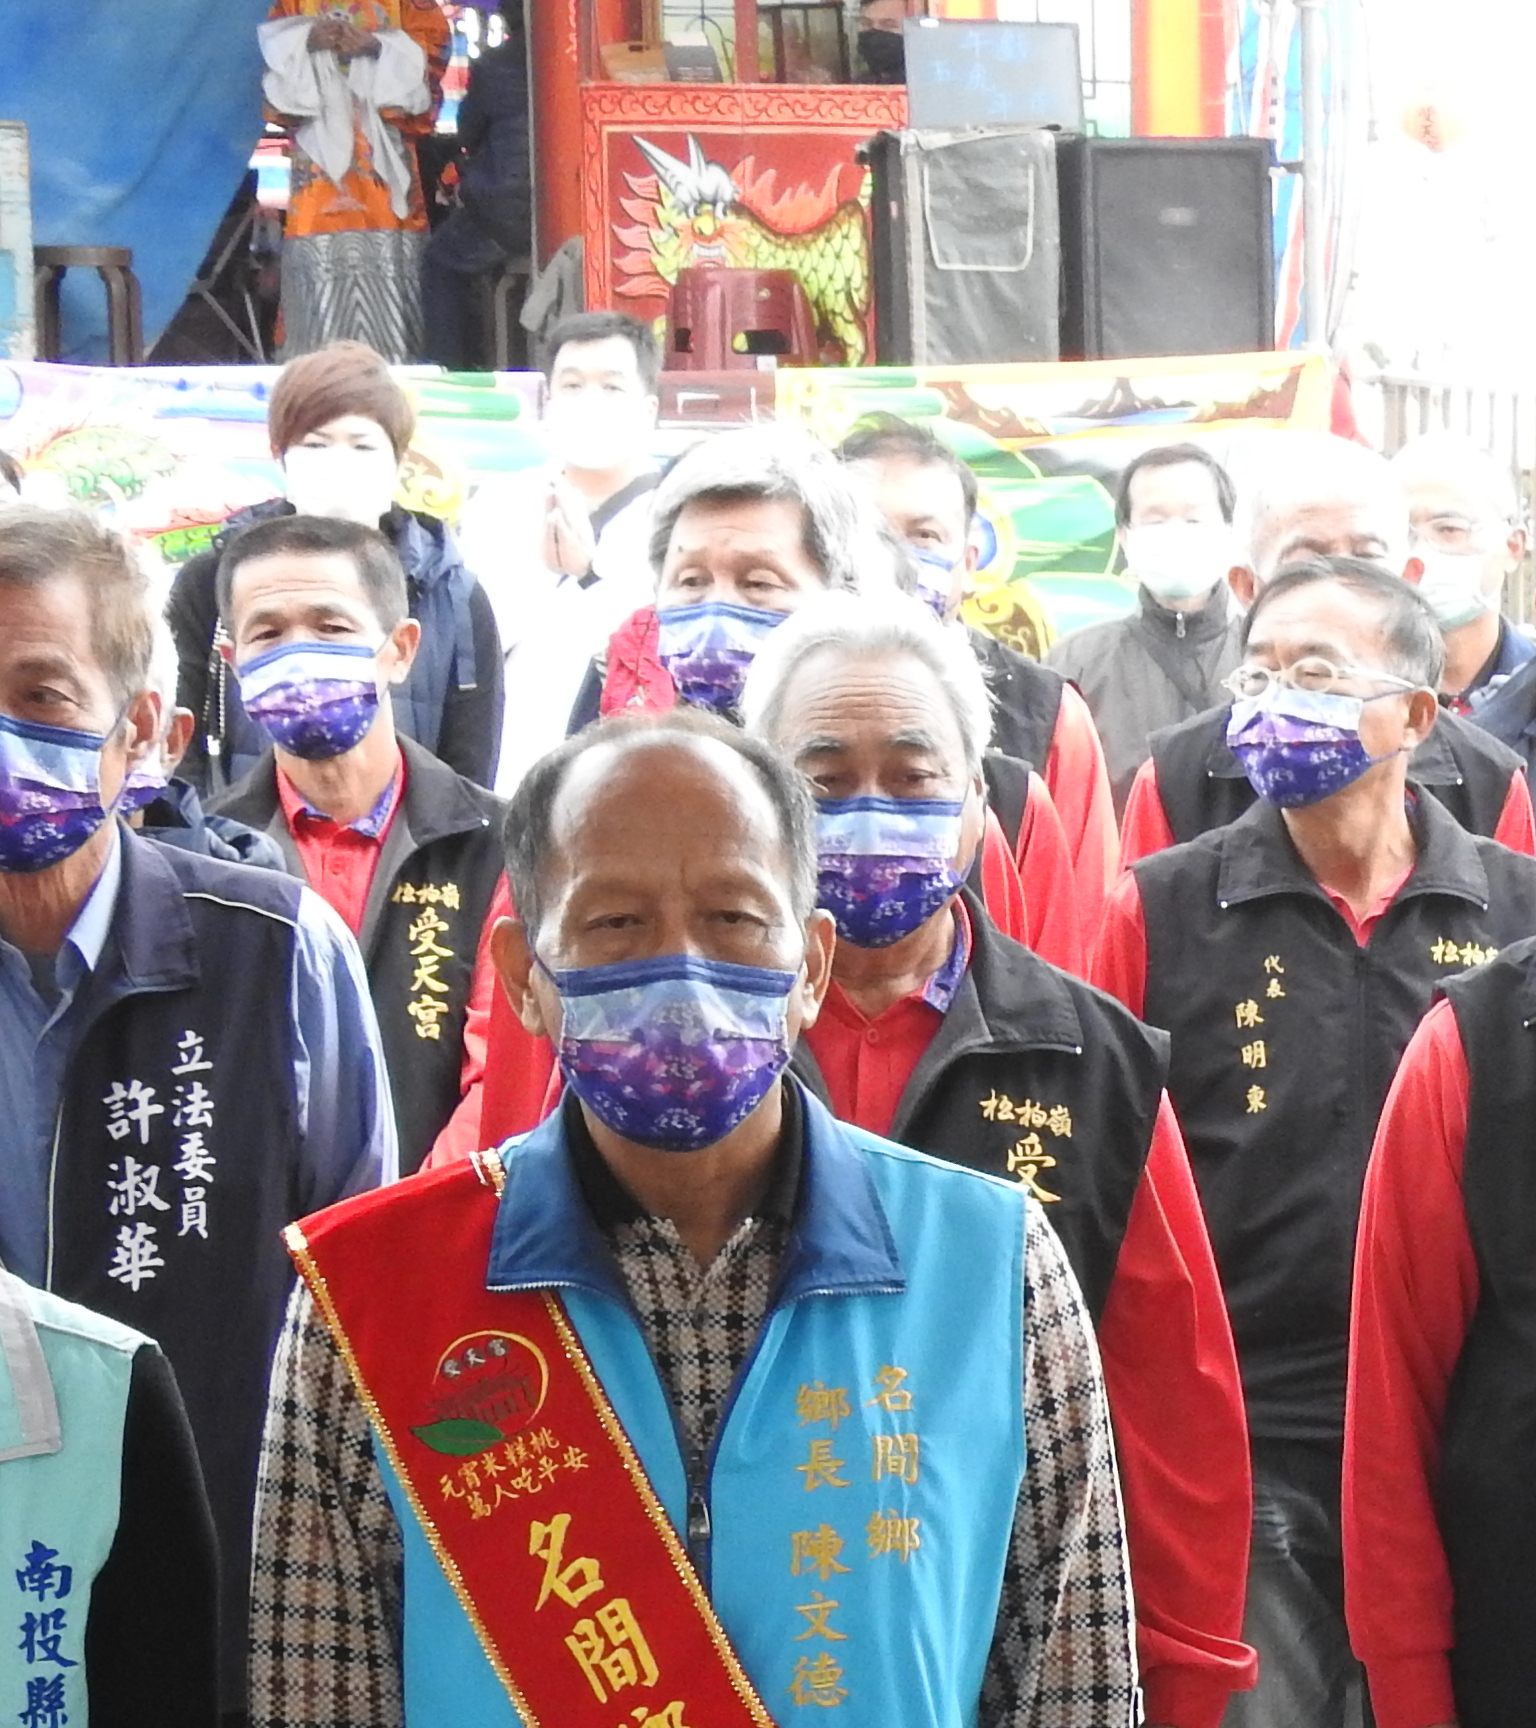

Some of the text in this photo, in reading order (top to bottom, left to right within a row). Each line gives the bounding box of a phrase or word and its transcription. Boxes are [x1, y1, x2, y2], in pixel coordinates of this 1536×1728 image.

[408, 907, 454, 1040] 受天宮
[1264, 955, 1286, 998] 代表
[979, 1088, 1072, 1138] 松柏嶺
[1235, 999, 1268, 1113] 陳明東
[103, 1079, 171, 1292] 許淑華
[171, 1030, 217, 1239] 立法委員
[466, 1446, 589, 1530] 萬人吃平安
[866, 1364, 921, 1562] 名間鄉
[787, 1380, 853, 1708] 鄉長 陳文德
